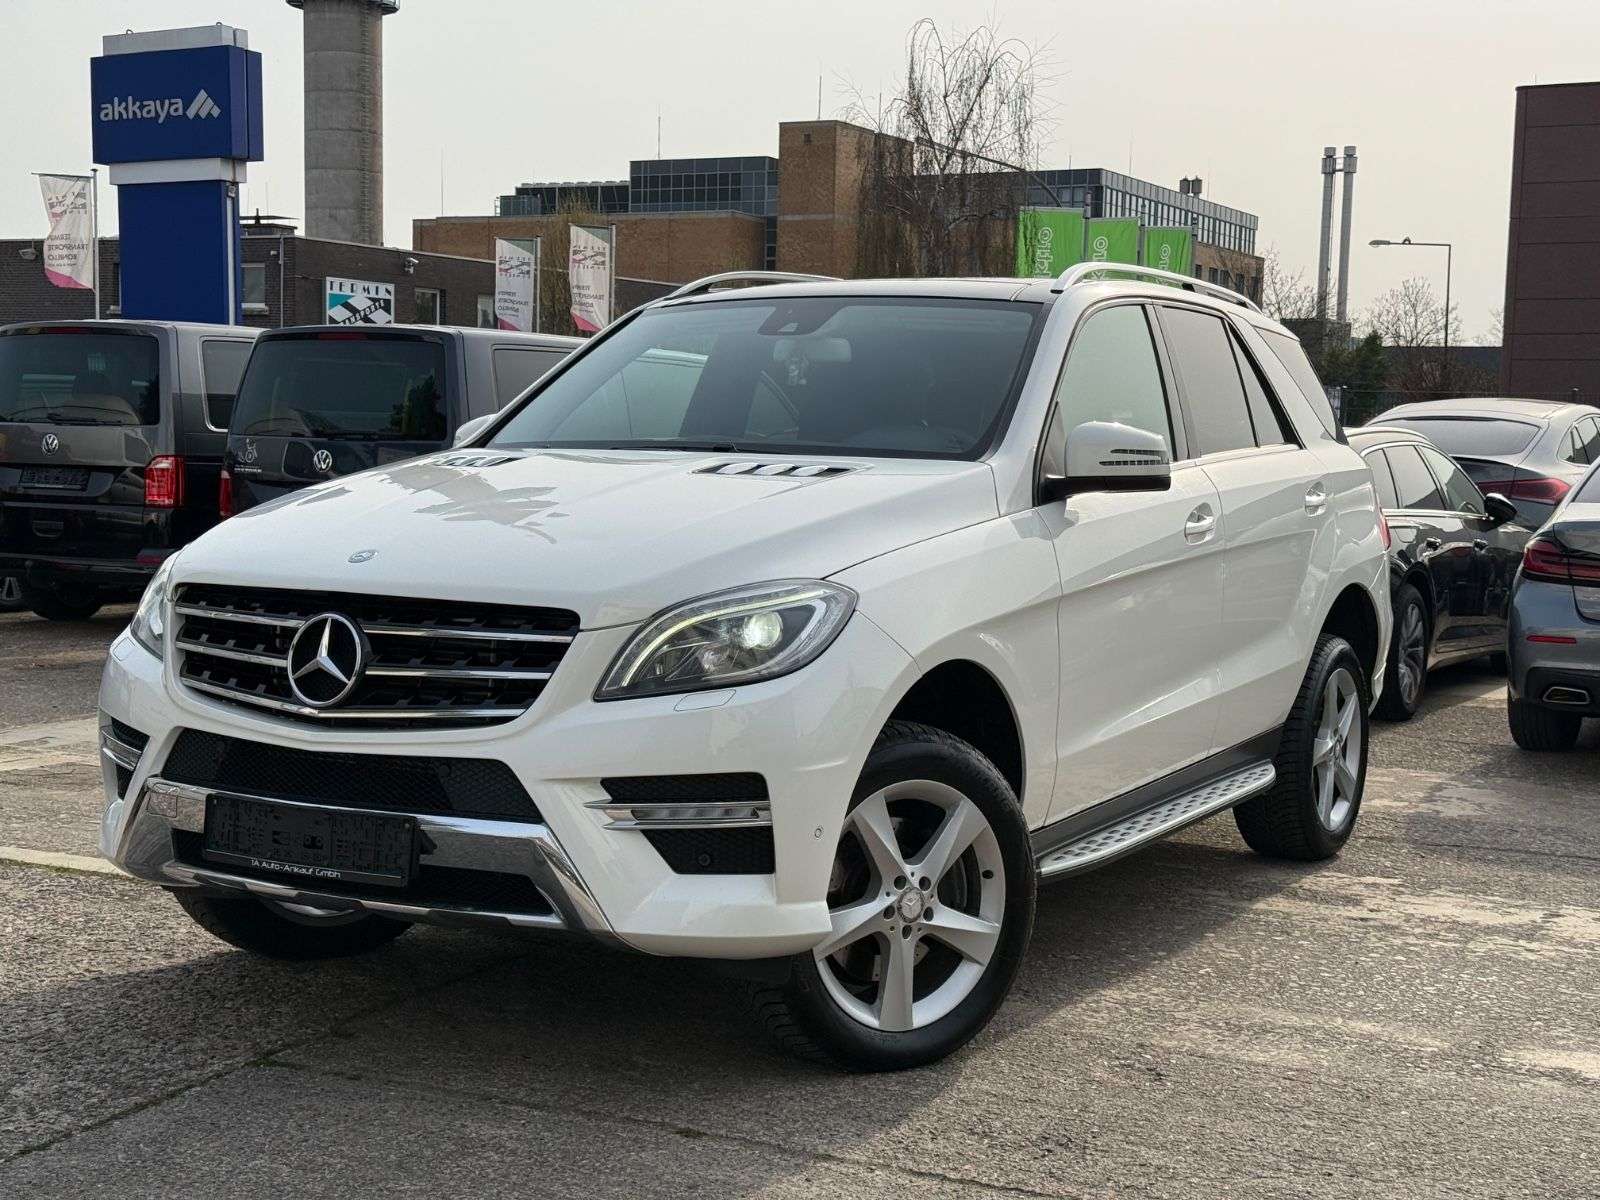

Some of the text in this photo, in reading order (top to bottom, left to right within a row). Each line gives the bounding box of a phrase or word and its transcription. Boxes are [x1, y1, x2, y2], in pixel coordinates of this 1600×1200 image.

[100, 96, 183, 124] akkaya
[329, 280, 392, 296] TERMIN
[261, 861, 313, 875] Auto-Ankauf
